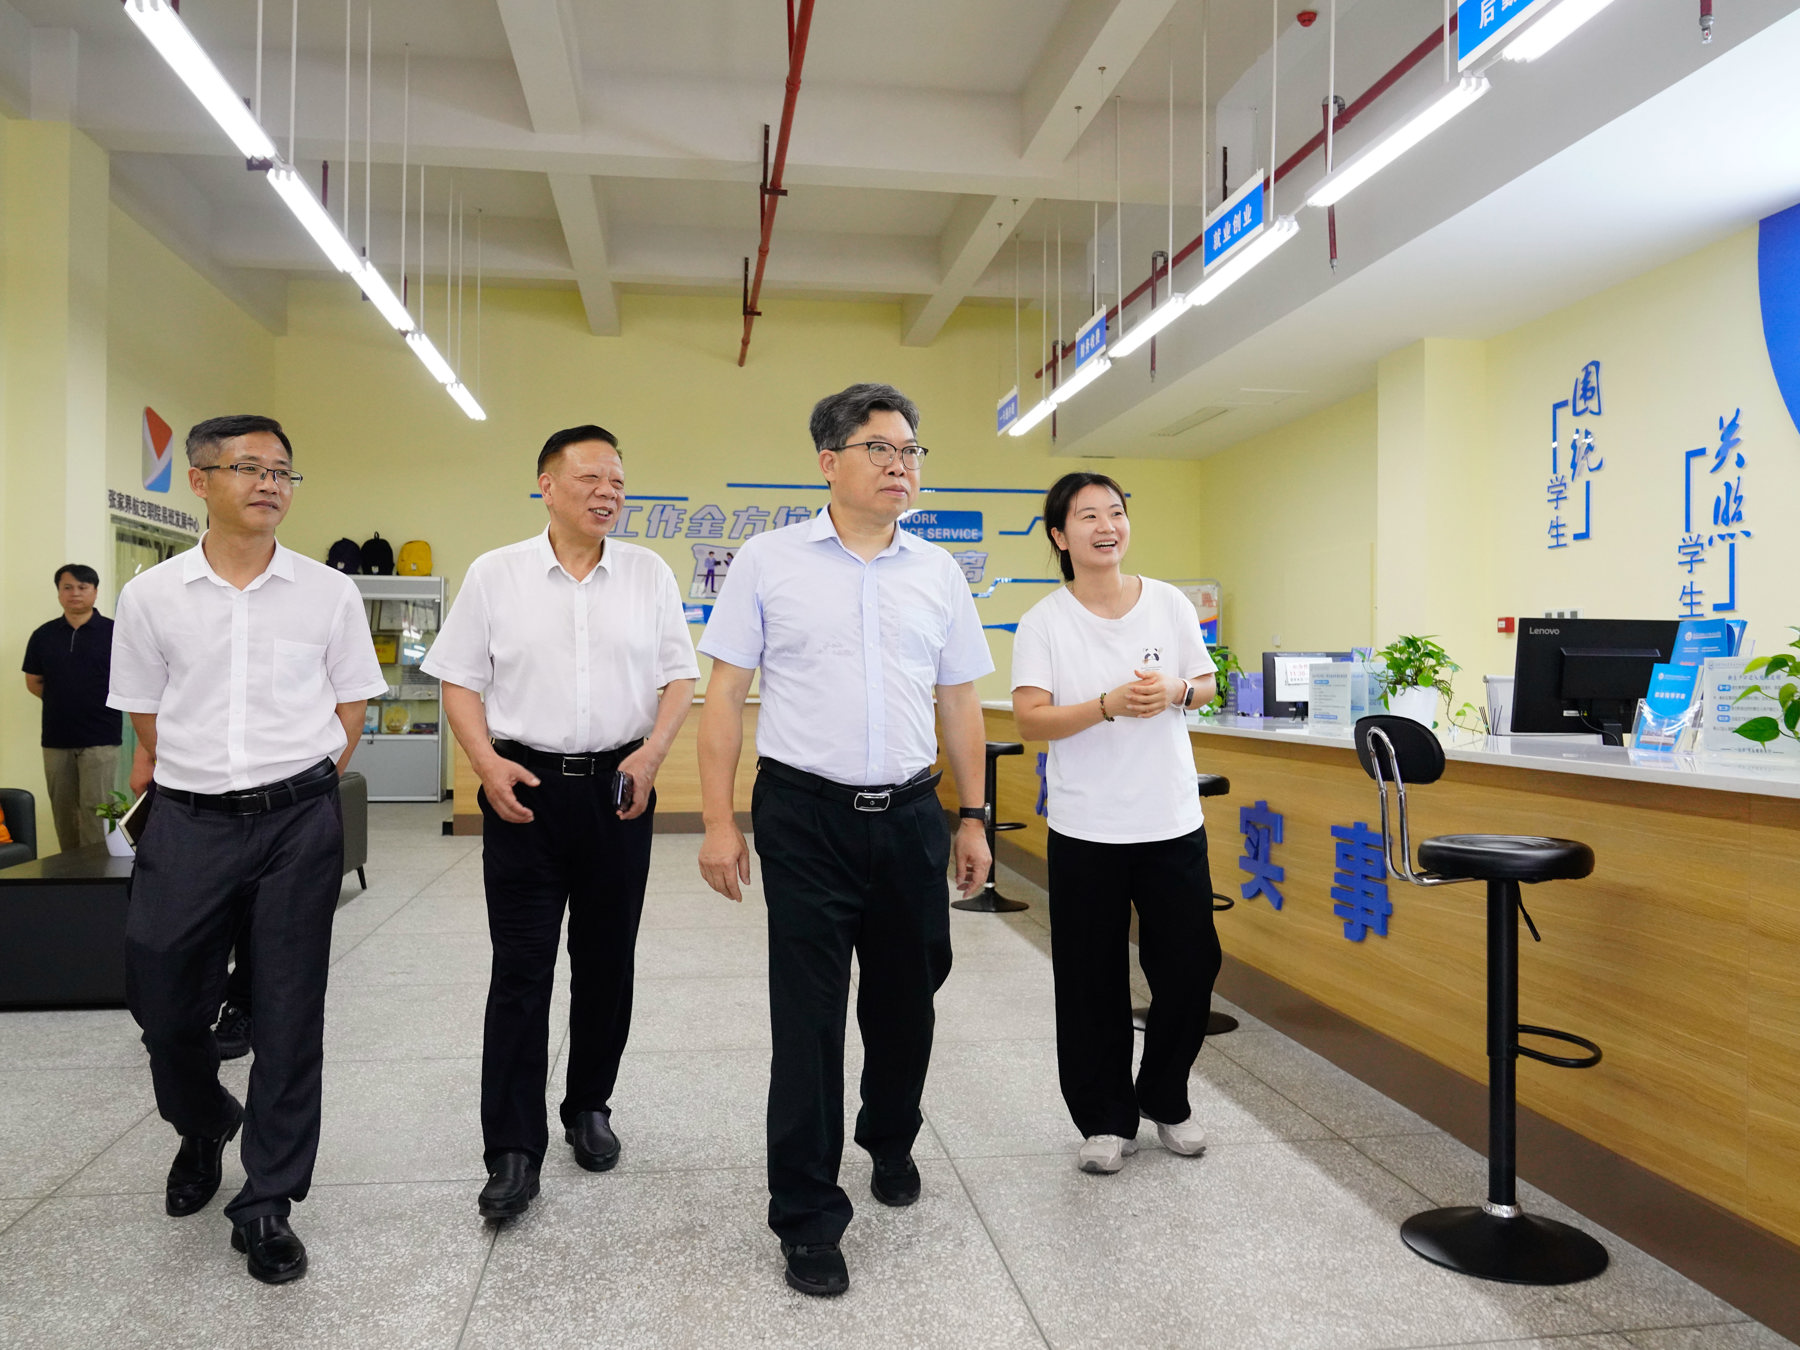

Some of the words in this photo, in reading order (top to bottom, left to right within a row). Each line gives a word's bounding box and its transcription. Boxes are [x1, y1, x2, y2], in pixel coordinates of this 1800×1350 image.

[1213, 203, 1252, 251] 就业创业
[1709, 408, 1752, 547] 关照
[927, 528, 979, 540] SERVICE
[1547, 475, 1567, 549] 学生
[1677, 534, 1705, 619] 学生
[1529, 626, 1560, 636] Lenovo
